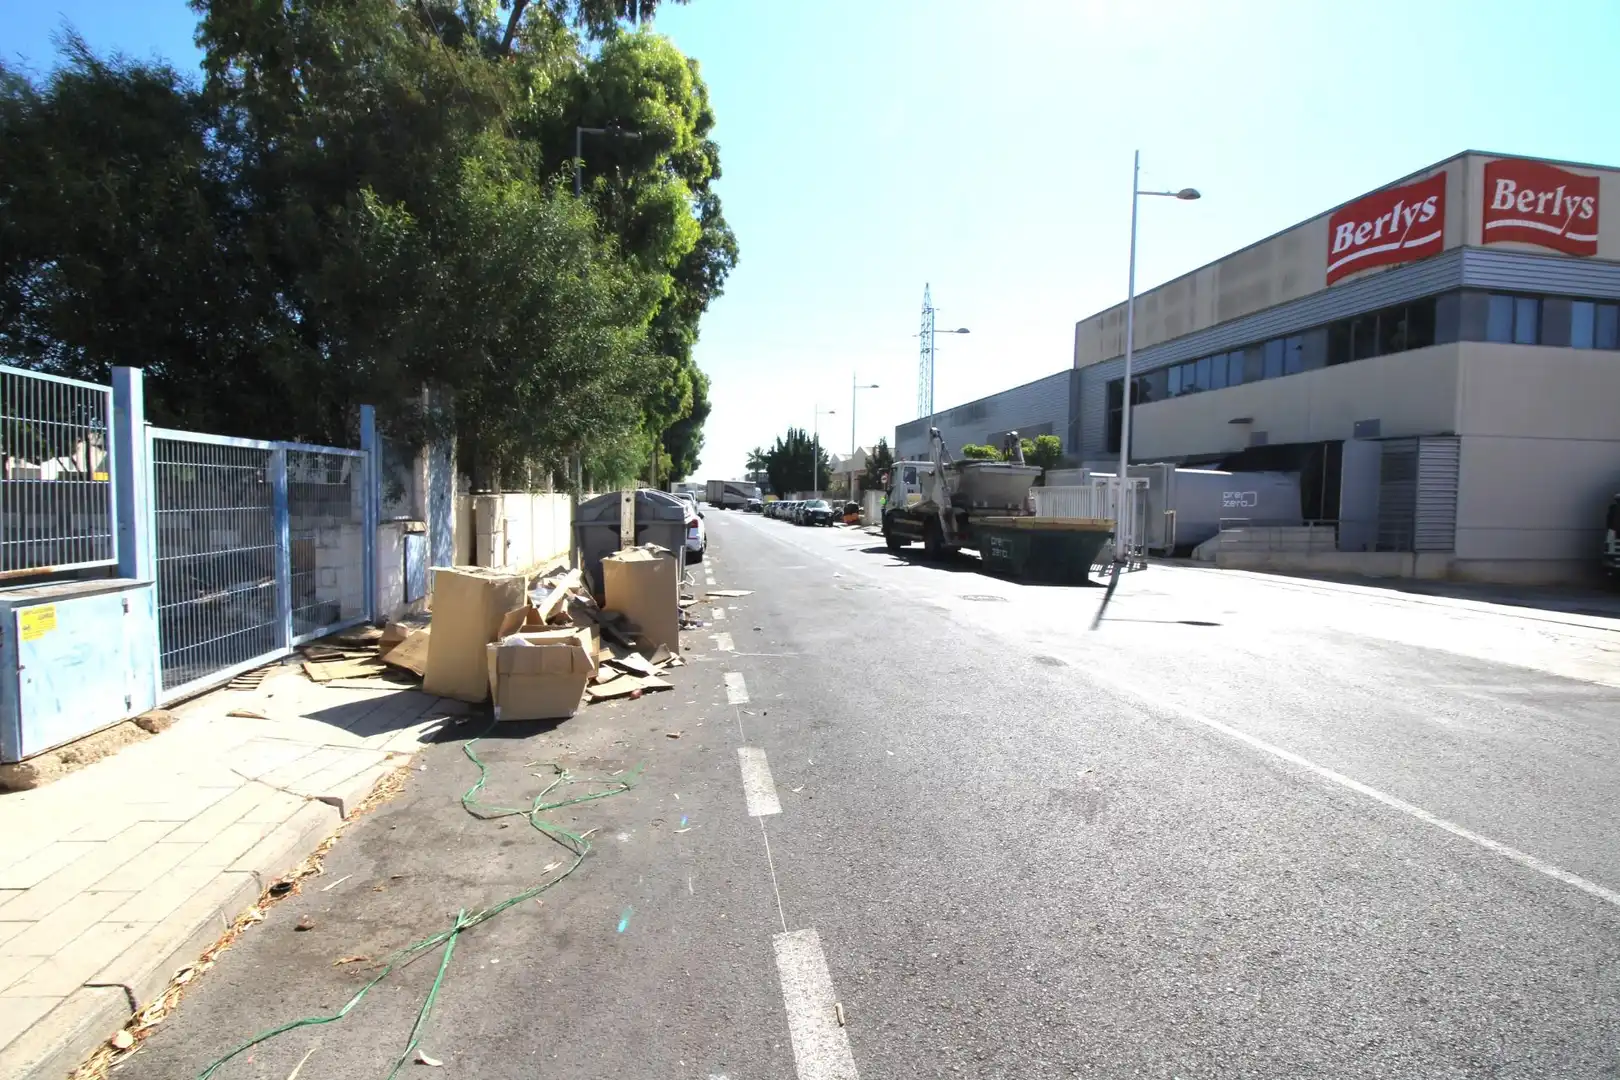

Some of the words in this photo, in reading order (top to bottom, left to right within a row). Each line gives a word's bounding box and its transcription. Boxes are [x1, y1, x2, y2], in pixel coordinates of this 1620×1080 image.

[1331, 195, 1438, 254] Berlys
[1491, 178, 1596, 232] Berlys
[1223, 491, 1241, 500] pre
